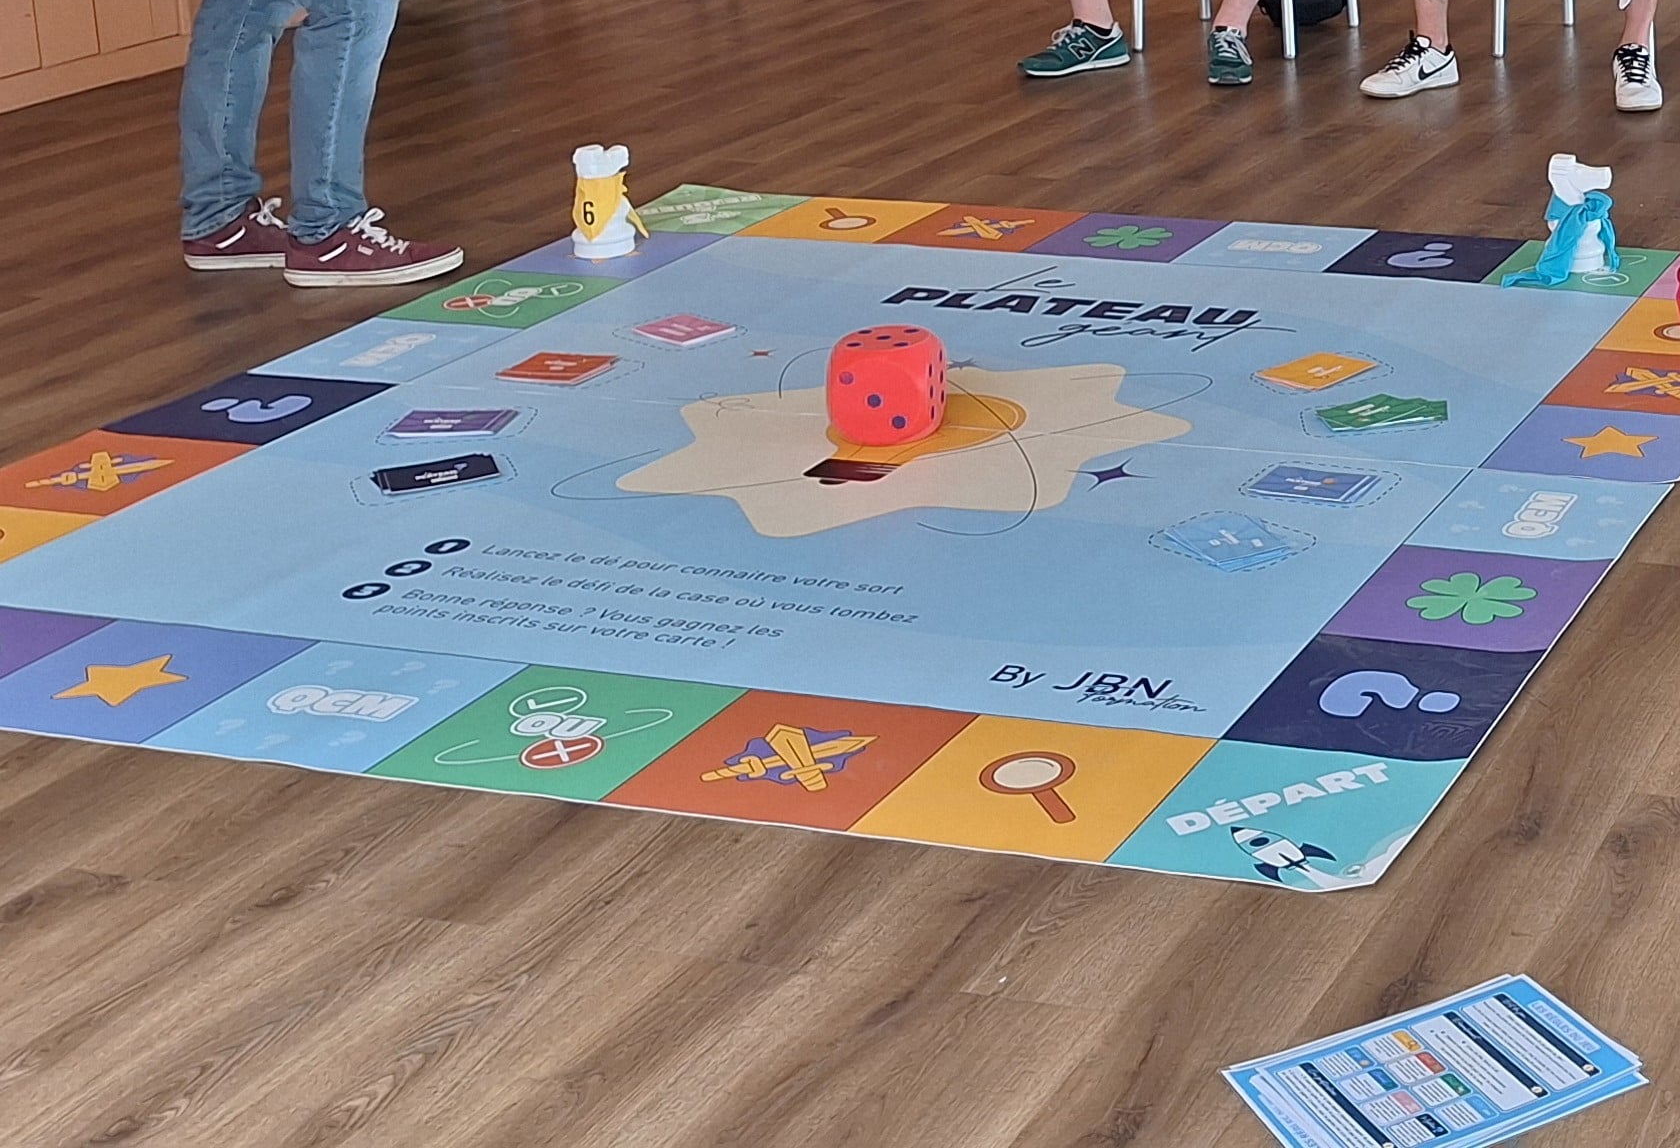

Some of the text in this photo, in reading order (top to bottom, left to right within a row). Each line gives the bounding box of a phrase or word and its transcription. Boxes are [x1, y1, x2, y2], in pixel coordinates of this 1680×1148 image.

[583, 201, 595, 225] 6
[958, 265, 1076, 294] Le
[881, 286, 1260, 326] PLATEAU
[1503, 492, 1578, 537] QCM
[481, 544, 561, 561] Lancez
[564, 553, 586, 563] le
[590, 554, 620, 566] dé
[619, 560, 678, 573] pour
[793, 576, 849, 590] votre
[854, 582, 905, 595] sort
[402, 589, 475, 606] Bonne
[478, 597, 573, 616] réponse
[598, 609, 651, 626] Vous
[650, 617, 743, 635] gagnez
[747, 625, 784, 638] les
[441, 566, 540, 585] Réalisez
[541, 576, 563, 587] le
[567, 578, 615, 593] défi
[615, 583, 644, 595] de
[648, 587, 671, 598] la
[675, 592, 730, 604] case
[735, 597, 765, 608] où
[770, 601, 824, 614] vous
[829, 606, 919, 624] tombez
[373, 604, 450, 619] points
[452, 610, 541, 629] inscrits
[543, 622, 586, 633] sur
[591, 625, 649, 640] votre
[654, 633, 716, 648] carte
[990, 664, 1172, 699] By JBN
[270, 686, 415, 720] QCM
[514, 713, 602, 738] OU
[1166, 763, 1390, 836] DÉPART
